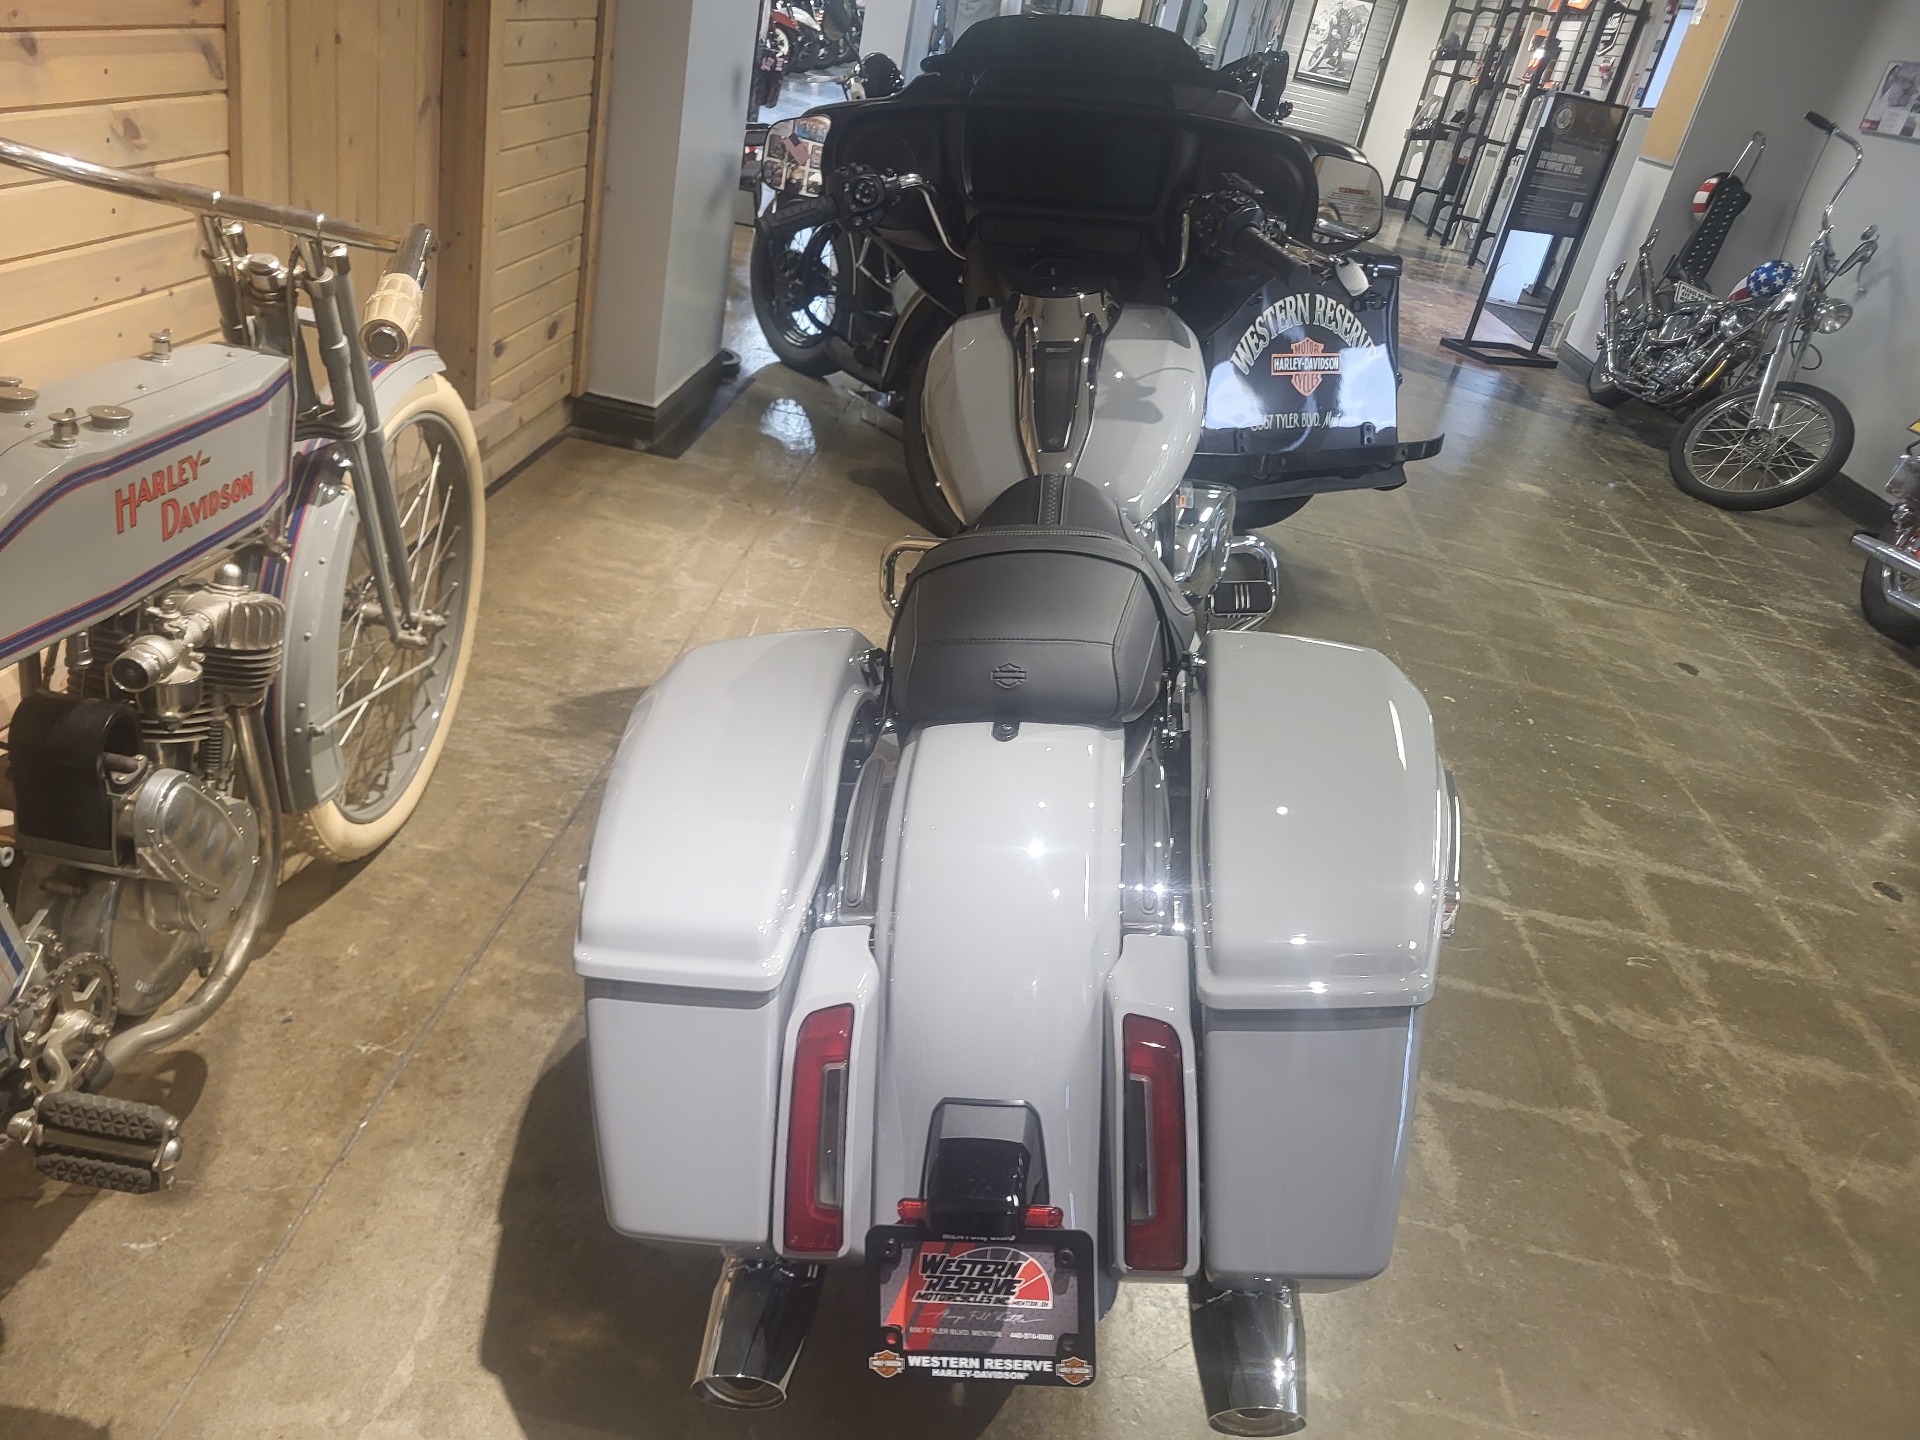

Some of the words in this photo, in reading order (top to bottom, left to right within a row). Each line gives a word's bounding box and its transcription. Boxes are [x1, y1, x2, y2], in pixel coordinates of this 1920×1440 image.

[1230, 293, 1310, 375] WESTERN
[1294, 341, 1320, 355] MOTOR
[1273, 356, 1339, 371] HARLEY-DAVIDSON
[1294, 373, 1320, 393] CYCLES
[1275, 413, 1300, 429] TYLER
[1301, 411, 1321, 428] BLVD.
[115, 450, 211, 535] HARLEY-
[161, 471, 254, 542] DAVIDSON
[919, 1254, 1023, 1278] WESTERN
[925, 1275, 1023, 1295] RESERVE
[907, 1355, 981, 1370] WESTERN
[984, 1358, 1054, 1372] RESERVE
